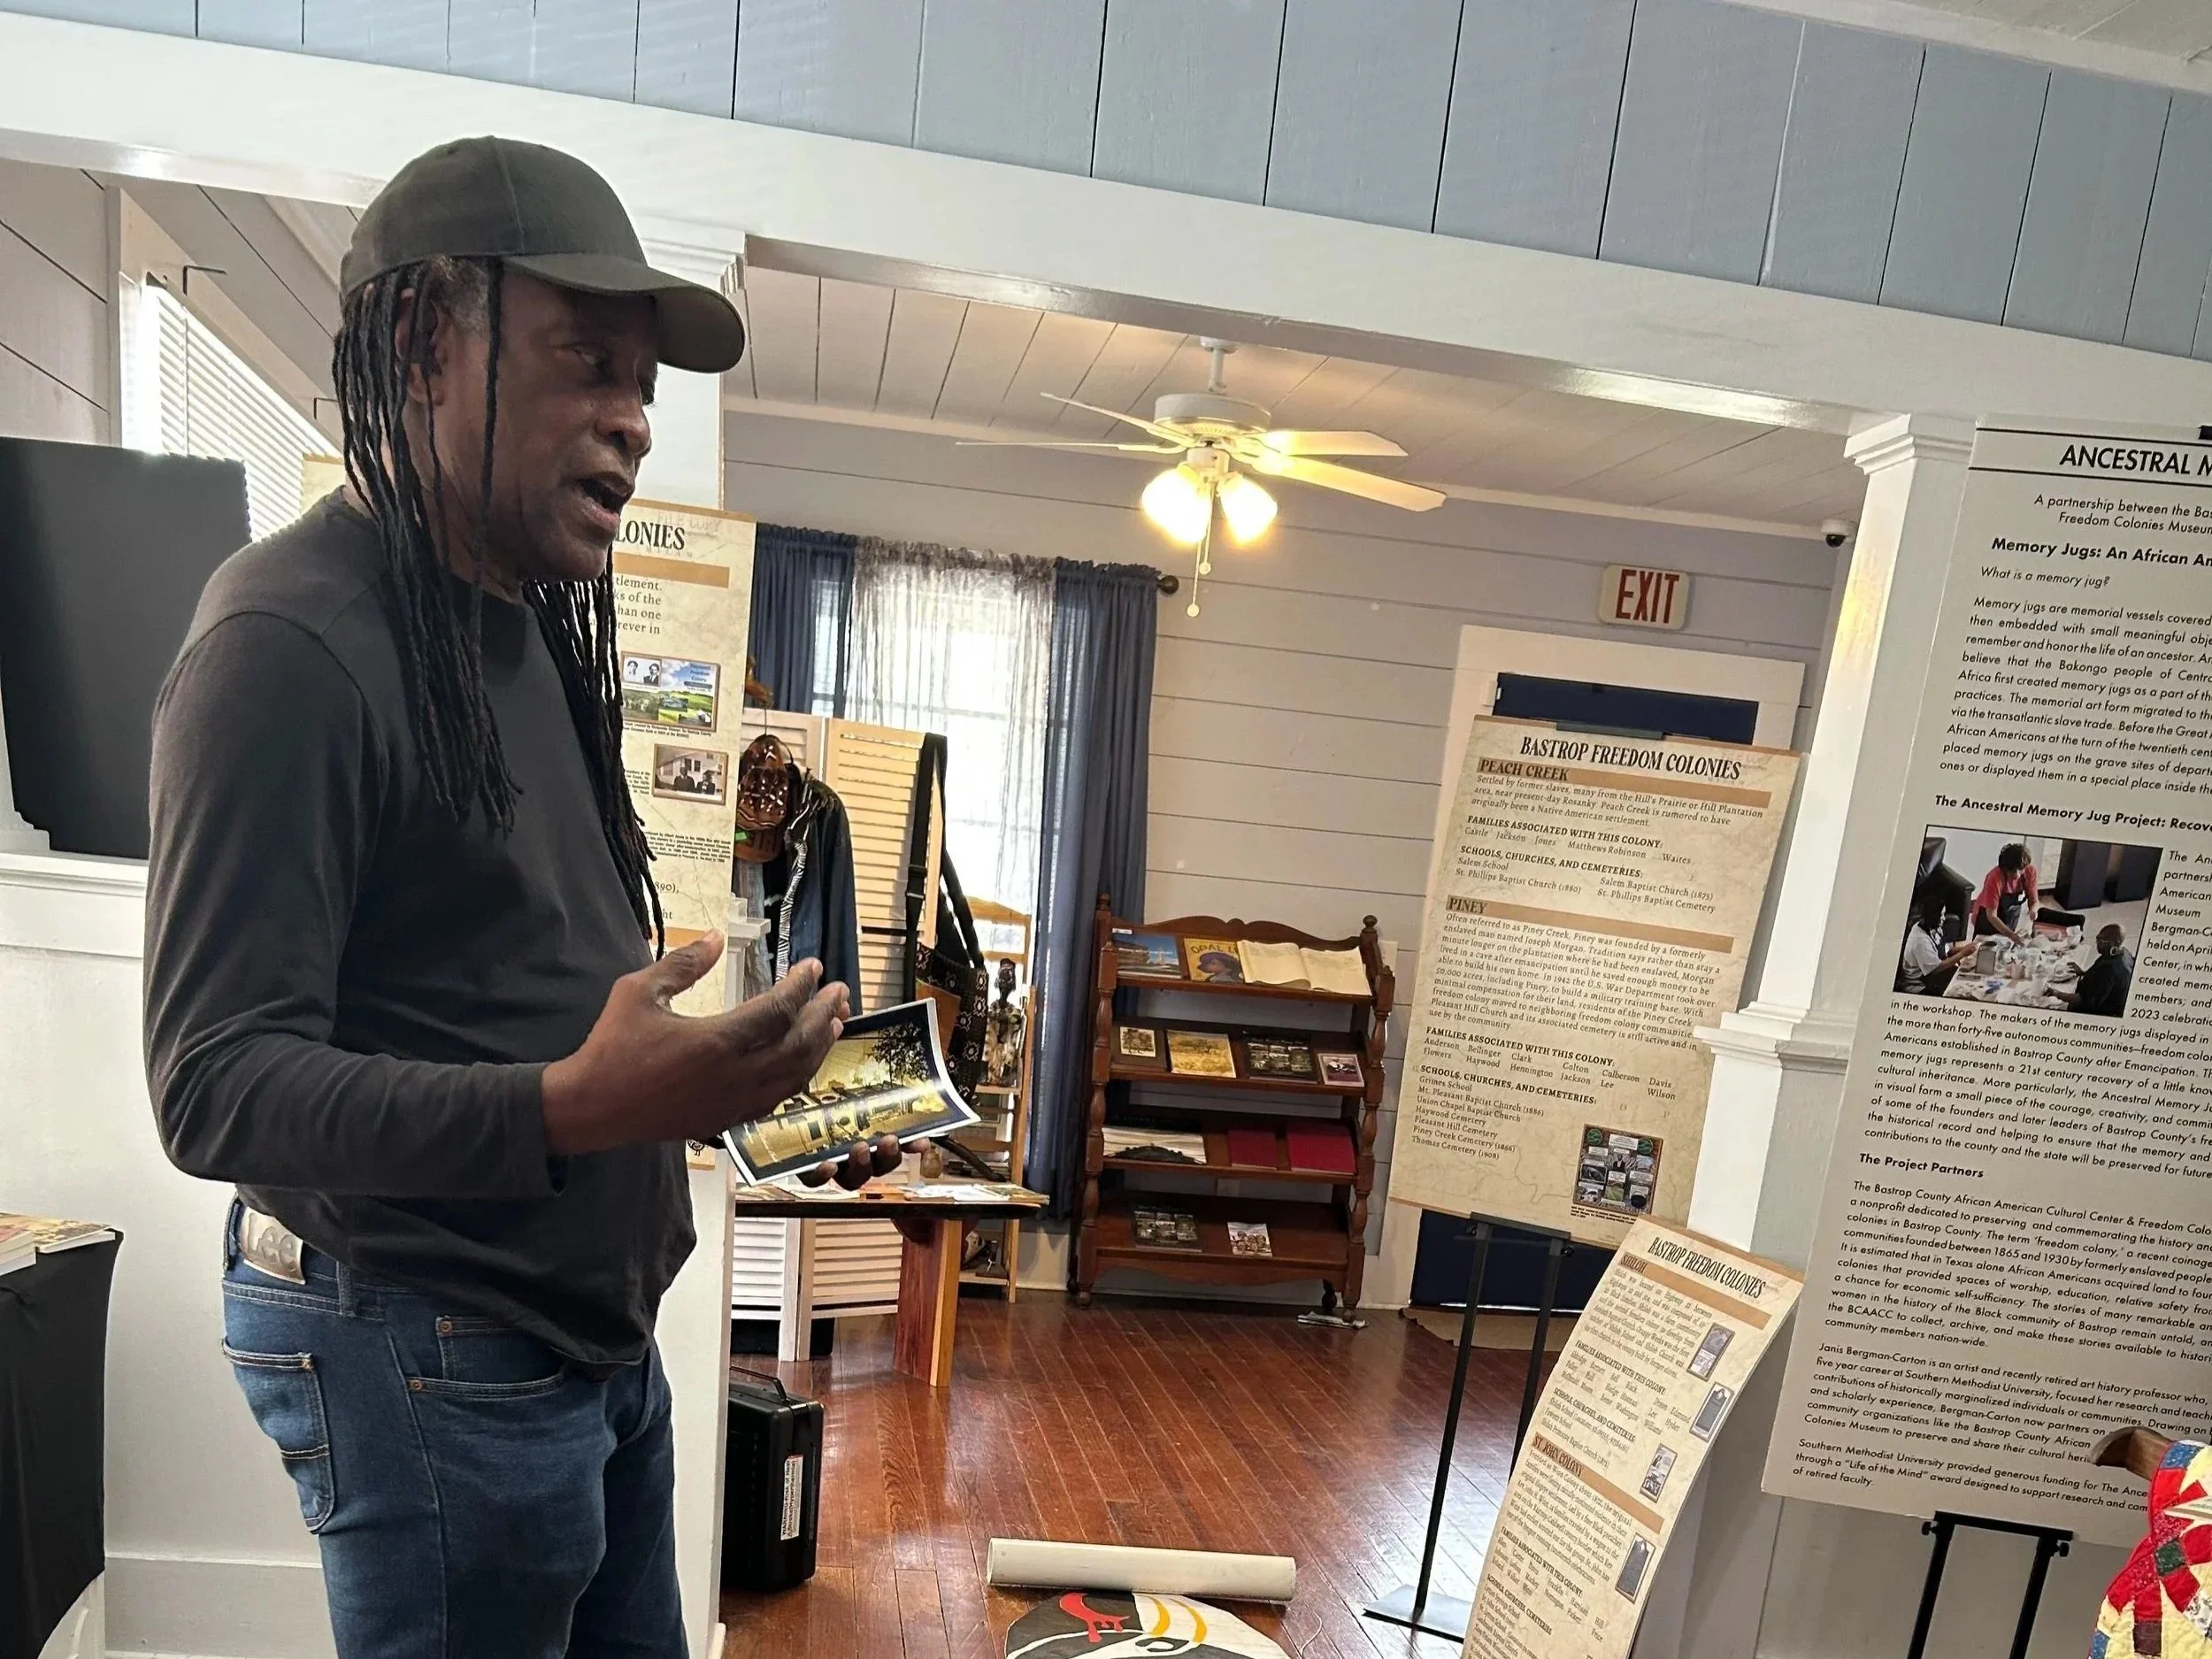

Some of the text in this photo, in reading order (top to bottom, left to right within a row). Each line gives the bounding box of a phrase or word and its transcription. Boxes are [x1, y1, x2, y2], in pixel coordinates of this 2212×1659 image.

[2059, 444, 2190, 474] ANCESTRAL
[2033, 494, 2190, 516] A partnership between the
[2059, 511, 2163, 530] Freedom Colonies
[616, 520, 685, 549] LONIES
[1991, 537, 2187, 565] Memory Jugs: An African
[616, 575, 663, 591] tlement.
[1981, 565, 2010, 578] What
[2036, 574, 2082, 587] memory
[2084, 576, 2109, 588] jug?
[628, 591, 642, 603] of
[643, 593, 662, 605] the
[1616, 569, 1679, 623] EXIT
[618, 603, 662, 619] han one
[1973, 596, 2021, 612] Memory
[2023, 603, 2045, 614] jugs
[2070, 607, 2124, 618] memorial
[2126, 610, 2163, 621] vessels
[618, 621, 660, 634] rever in
[1970, 614, 2185, 644] then embedded with small meaningful
[1962, 650, 2172, 679] believe that the Bakongo people of
[1480, 759, 1569, 780] PEACH CREEK
[1520, 736, 1741, 780] BASTROP FREEDOM COLONIES
[1935, 795, 2165, 827] The Ancestral Memory Jug Project:
[1467, 815, 1509, 827] FAMILIES
[1509, 820, 1567, 835] ASSOCIATED
[1570, 828, 1595, 839] WITH
[1598, 832, 1619, 841] THIS
[1457, 856, 1509, 870] Salem School
[1558, 858, 1579, 868] AND
[1600, 876, 1624, 887] Salem
[1626, 879, 1655, 891] Baptist
[1658, 885, 1688, 896] Church
[1448, 897, 1486, 914] PINEY
[2154, 903, 2200, 918] Museum
[1191, 944, 1223, 954] OPAL
[2139, 976, 2180, 988] created
[1902, 1000, 1918, 1010] the
[1922, 1004, 1975, 1018] workshop.
[1979, 1009, 1996, 1020] The
[2000, 1012, 2036, 1025] makers
[2040, 1016, 2052, 1025] of
[2054, 1017, 2070, 1028] the
[2073, 1023, 2116, 1036] memory
[2119, 1028, 2140, 1038] jugs
[2144, 1027, 2196, 1043] displayed
[2131, 1007, 2160, 1020] 2023
[1425, 1026, 1466, 1040] FAMILIES
[1467, 1033, 1523, 1049] ASSOCIATED
[1525, 1044, 1549, 1055] WITH
[1551, 1048, 1573, 1058] THIS
[1423, 1047, 1675, 1099] Flowers Haywood Hennington Jackson Lee Wilson
[1515, 1082, 1534, 1092] AND
[1859, 1153, 1983, 1177] The Project Partners
[1854, 1180, 2183, 1231] The Bastrop County African American Cultural Center & Freedom
[248, 1212, 298, 1271] Lee
[1647, 1237, 1766, 1299] BASTROP FREEDOM COLONIES
[1827, 1302, 1843, 1311] the
[1847, 1304, 1893, 1318] BCAACC
[1910, 1314, 1944, 1327] collect,
[1949, 1320, 1988, 1333] archive,
[1993, 1326, 2014, 1335] and
[2016, 1329, 2044, 1339] make
[2047, 1332, 2074, 1343] these
[2078, 1338, 2110, 1348] stories
[2115, 1343, 2162, 1356] available
[2166, 1348, 2176, 1357] to
[1559, 1452, 1584, 1478] COLONY
[1798, 1438, 2118, 1493] Southern Methodist University provided generous funding for The
[1805, 1470, 1837, 1479] retired
[1839, 1471, 1874, 1486] faculty.
